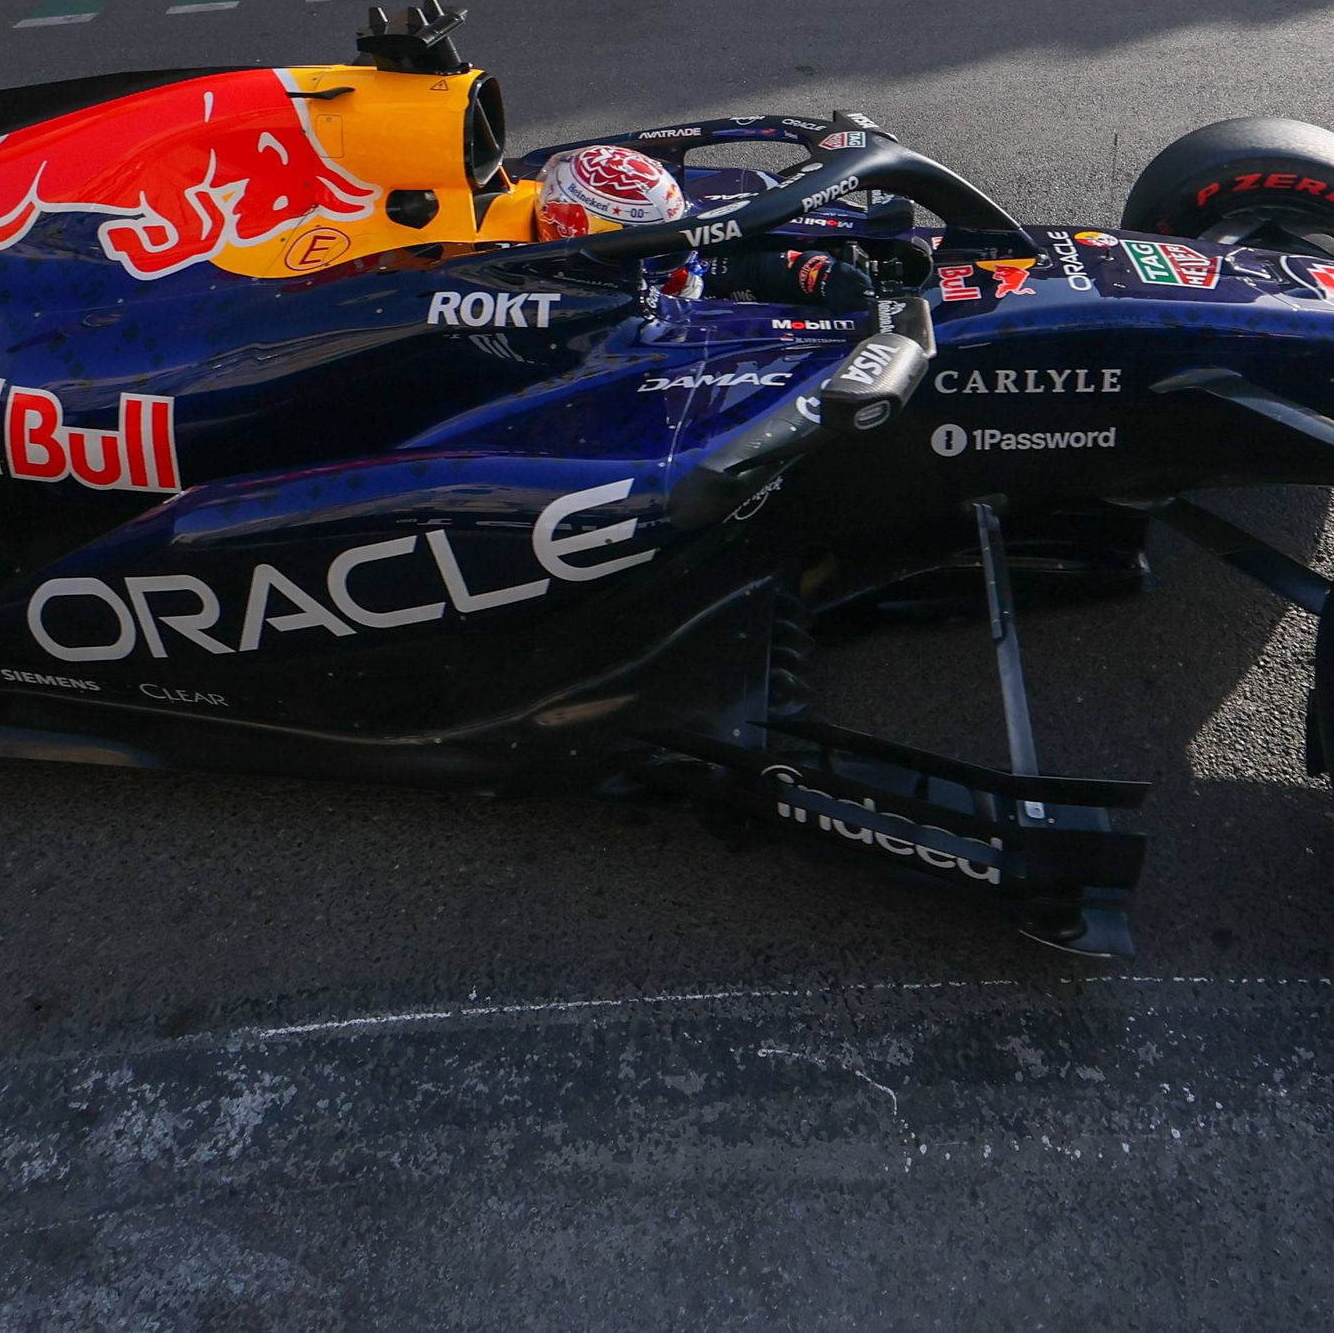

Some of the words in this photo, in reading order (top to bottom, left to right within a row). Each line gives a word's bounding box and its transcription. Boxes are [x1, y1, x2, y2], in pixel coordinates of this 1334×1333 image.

[638, 127, 702, 139] AVATRADE
[781, 118, 827, 132] ORACLE
[848, 131, 863, 147] TAG
[568, 181, 608, 212] Heineken
[801, 176, 860, 213] PRYPCO
[1197, 183, 1220, 206] P
[679, 220, 743, 248] VISA
[300, 238, 328, 264] E
[1047, 230, 1092, 292] ORACLE
[1131, 243, 1165, 280] TAG
[1168, 245, 1212, 287] HEUER
[938, 265, 981, 301] Bull
[426, 291, 562, 328] ROKT
[771, 319, 832, 331] Mobil
[841, 342, 897, 385] VISA
[637, 373, 793, 393] DAMAC
[934, 369, 1123, 395] CARLYLE
[9, 388, 179, 491] Bull
[973, 425, 1116, 451] 1Password
[27, 477, 660, 662] ORACLE
[1, 668, 101, 692] SIEMENS
[139, 682, 230, 707] CLEAR
[775, 772, 1002, 886] indeed
